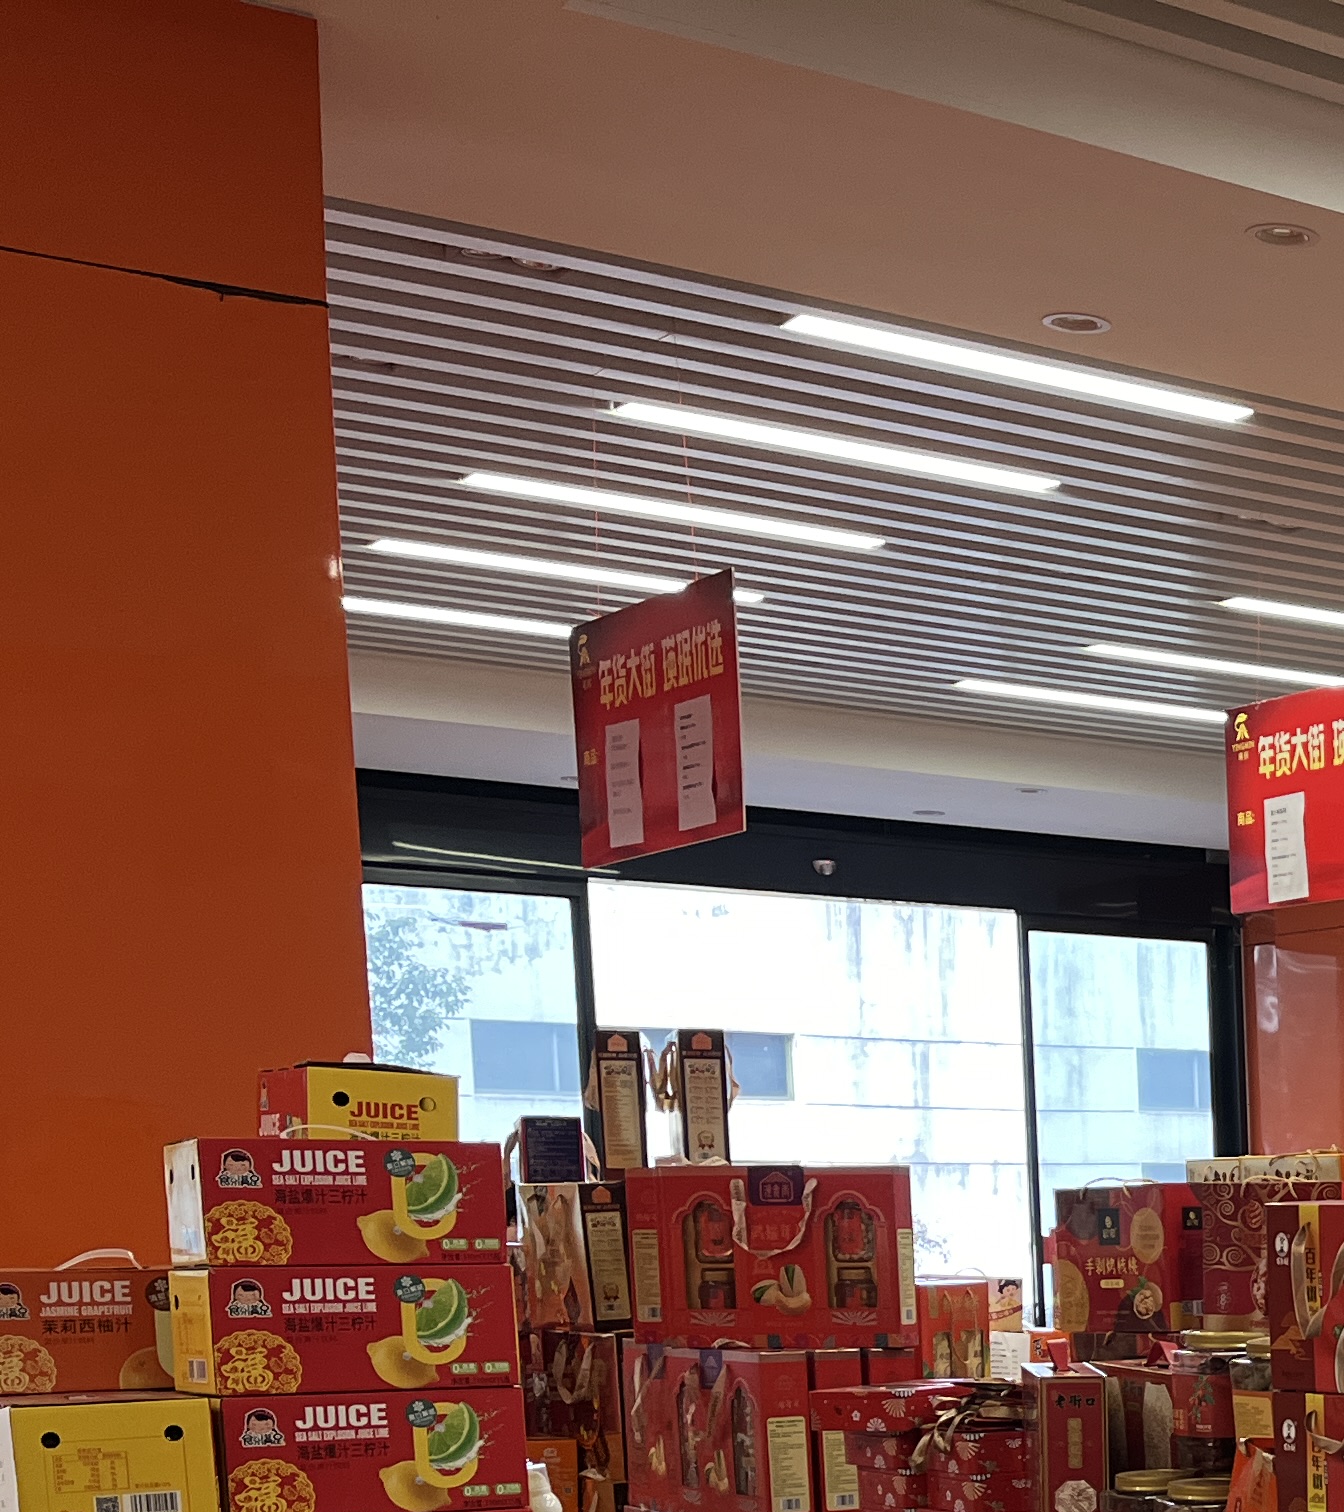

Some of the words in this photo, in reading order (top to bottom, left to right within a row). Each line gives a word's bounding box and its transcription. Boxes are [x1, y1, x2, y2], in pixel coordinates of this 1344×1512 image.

[599, 642, 656, 711] 年货大街
[661, 618, 724, 692] 瑛珉优选
[1257, 723, 1325, 779] 年货大街
[350, 1100, 420, 1121] JUICE
[272, 1149, 366, 1173] JUICE
[40, 1279, 132, 1304] JUICE
[282, 1277, 377, 1301] JUICE
[40, 1304, 79, 1317] JASMINE
[81, 1304, 133, 1317] GRAPEFRUIT
[42, 1316, 132, 1336] 茉莉西柚汁
[294, 1403, 389, 1427] JUICE
